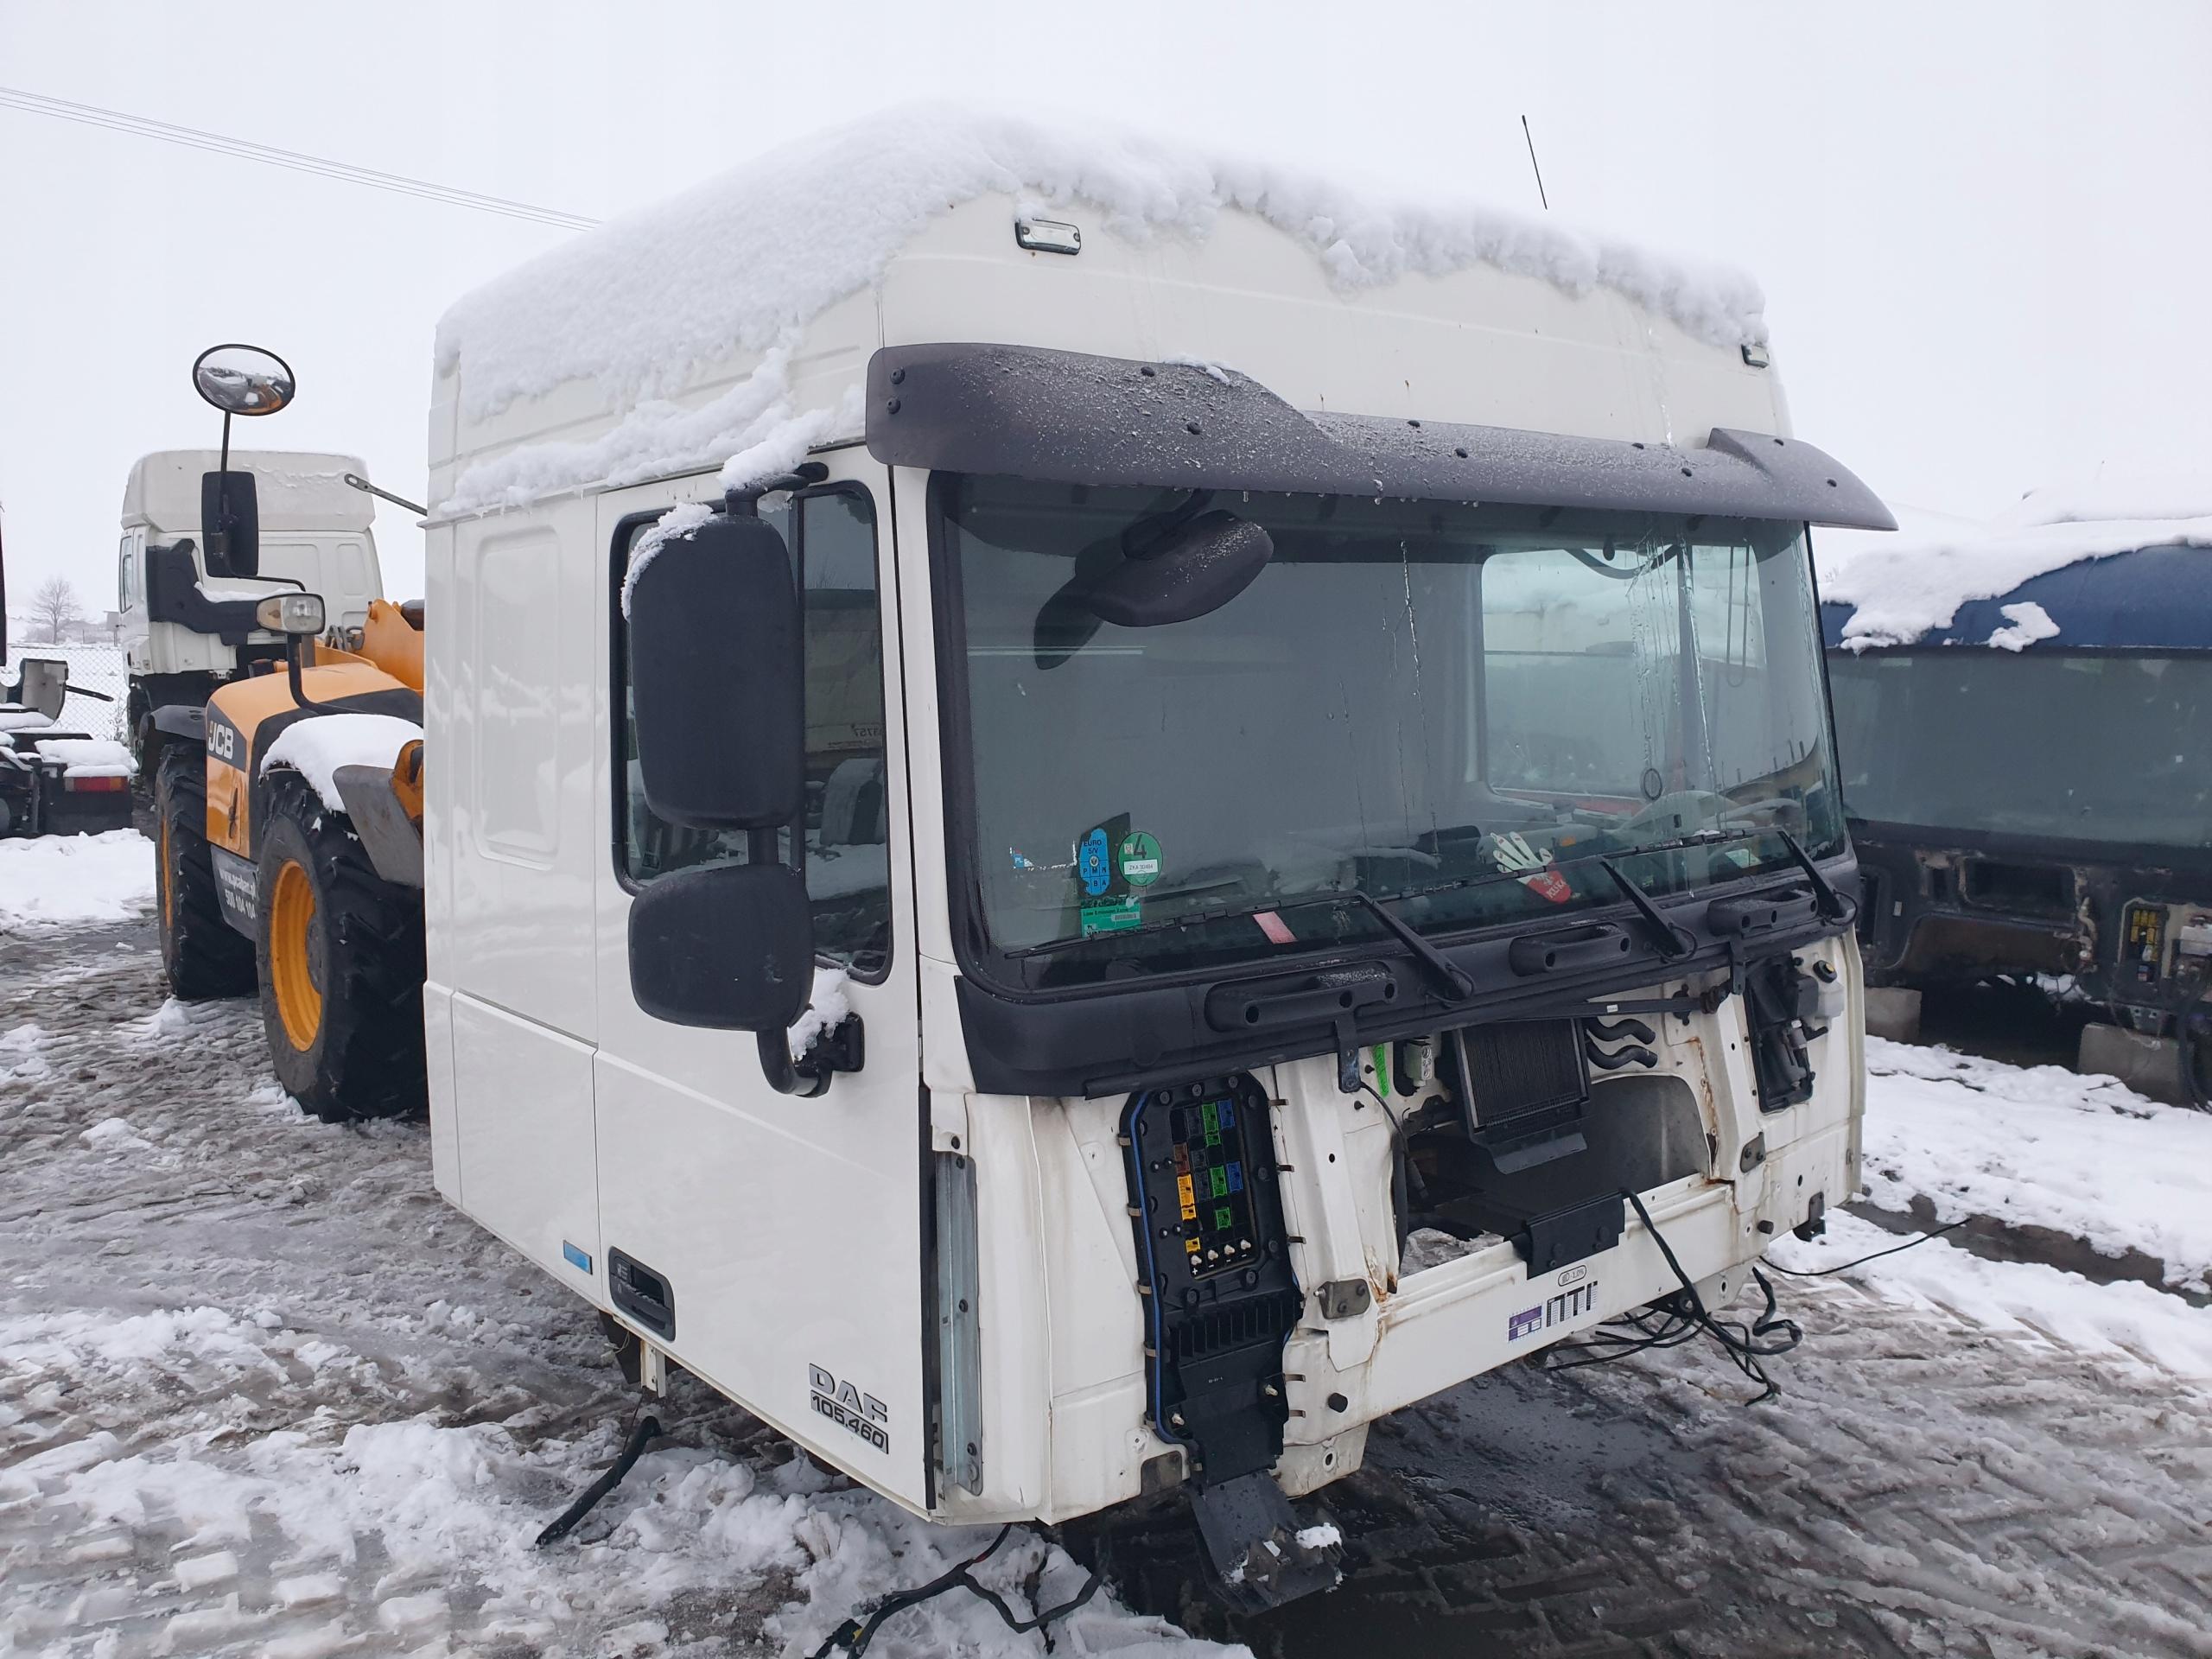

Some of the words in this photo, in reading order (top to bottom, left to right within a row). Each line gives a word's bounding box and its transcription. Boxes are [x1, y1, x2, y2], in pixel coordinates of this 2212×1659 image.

[208, 720, 233, 760] JCB
[1134, 834, 1147, 859] 4
[809, 1363, 888, 1423] DAF
[811, 1394, 885, 1450] 105.460
